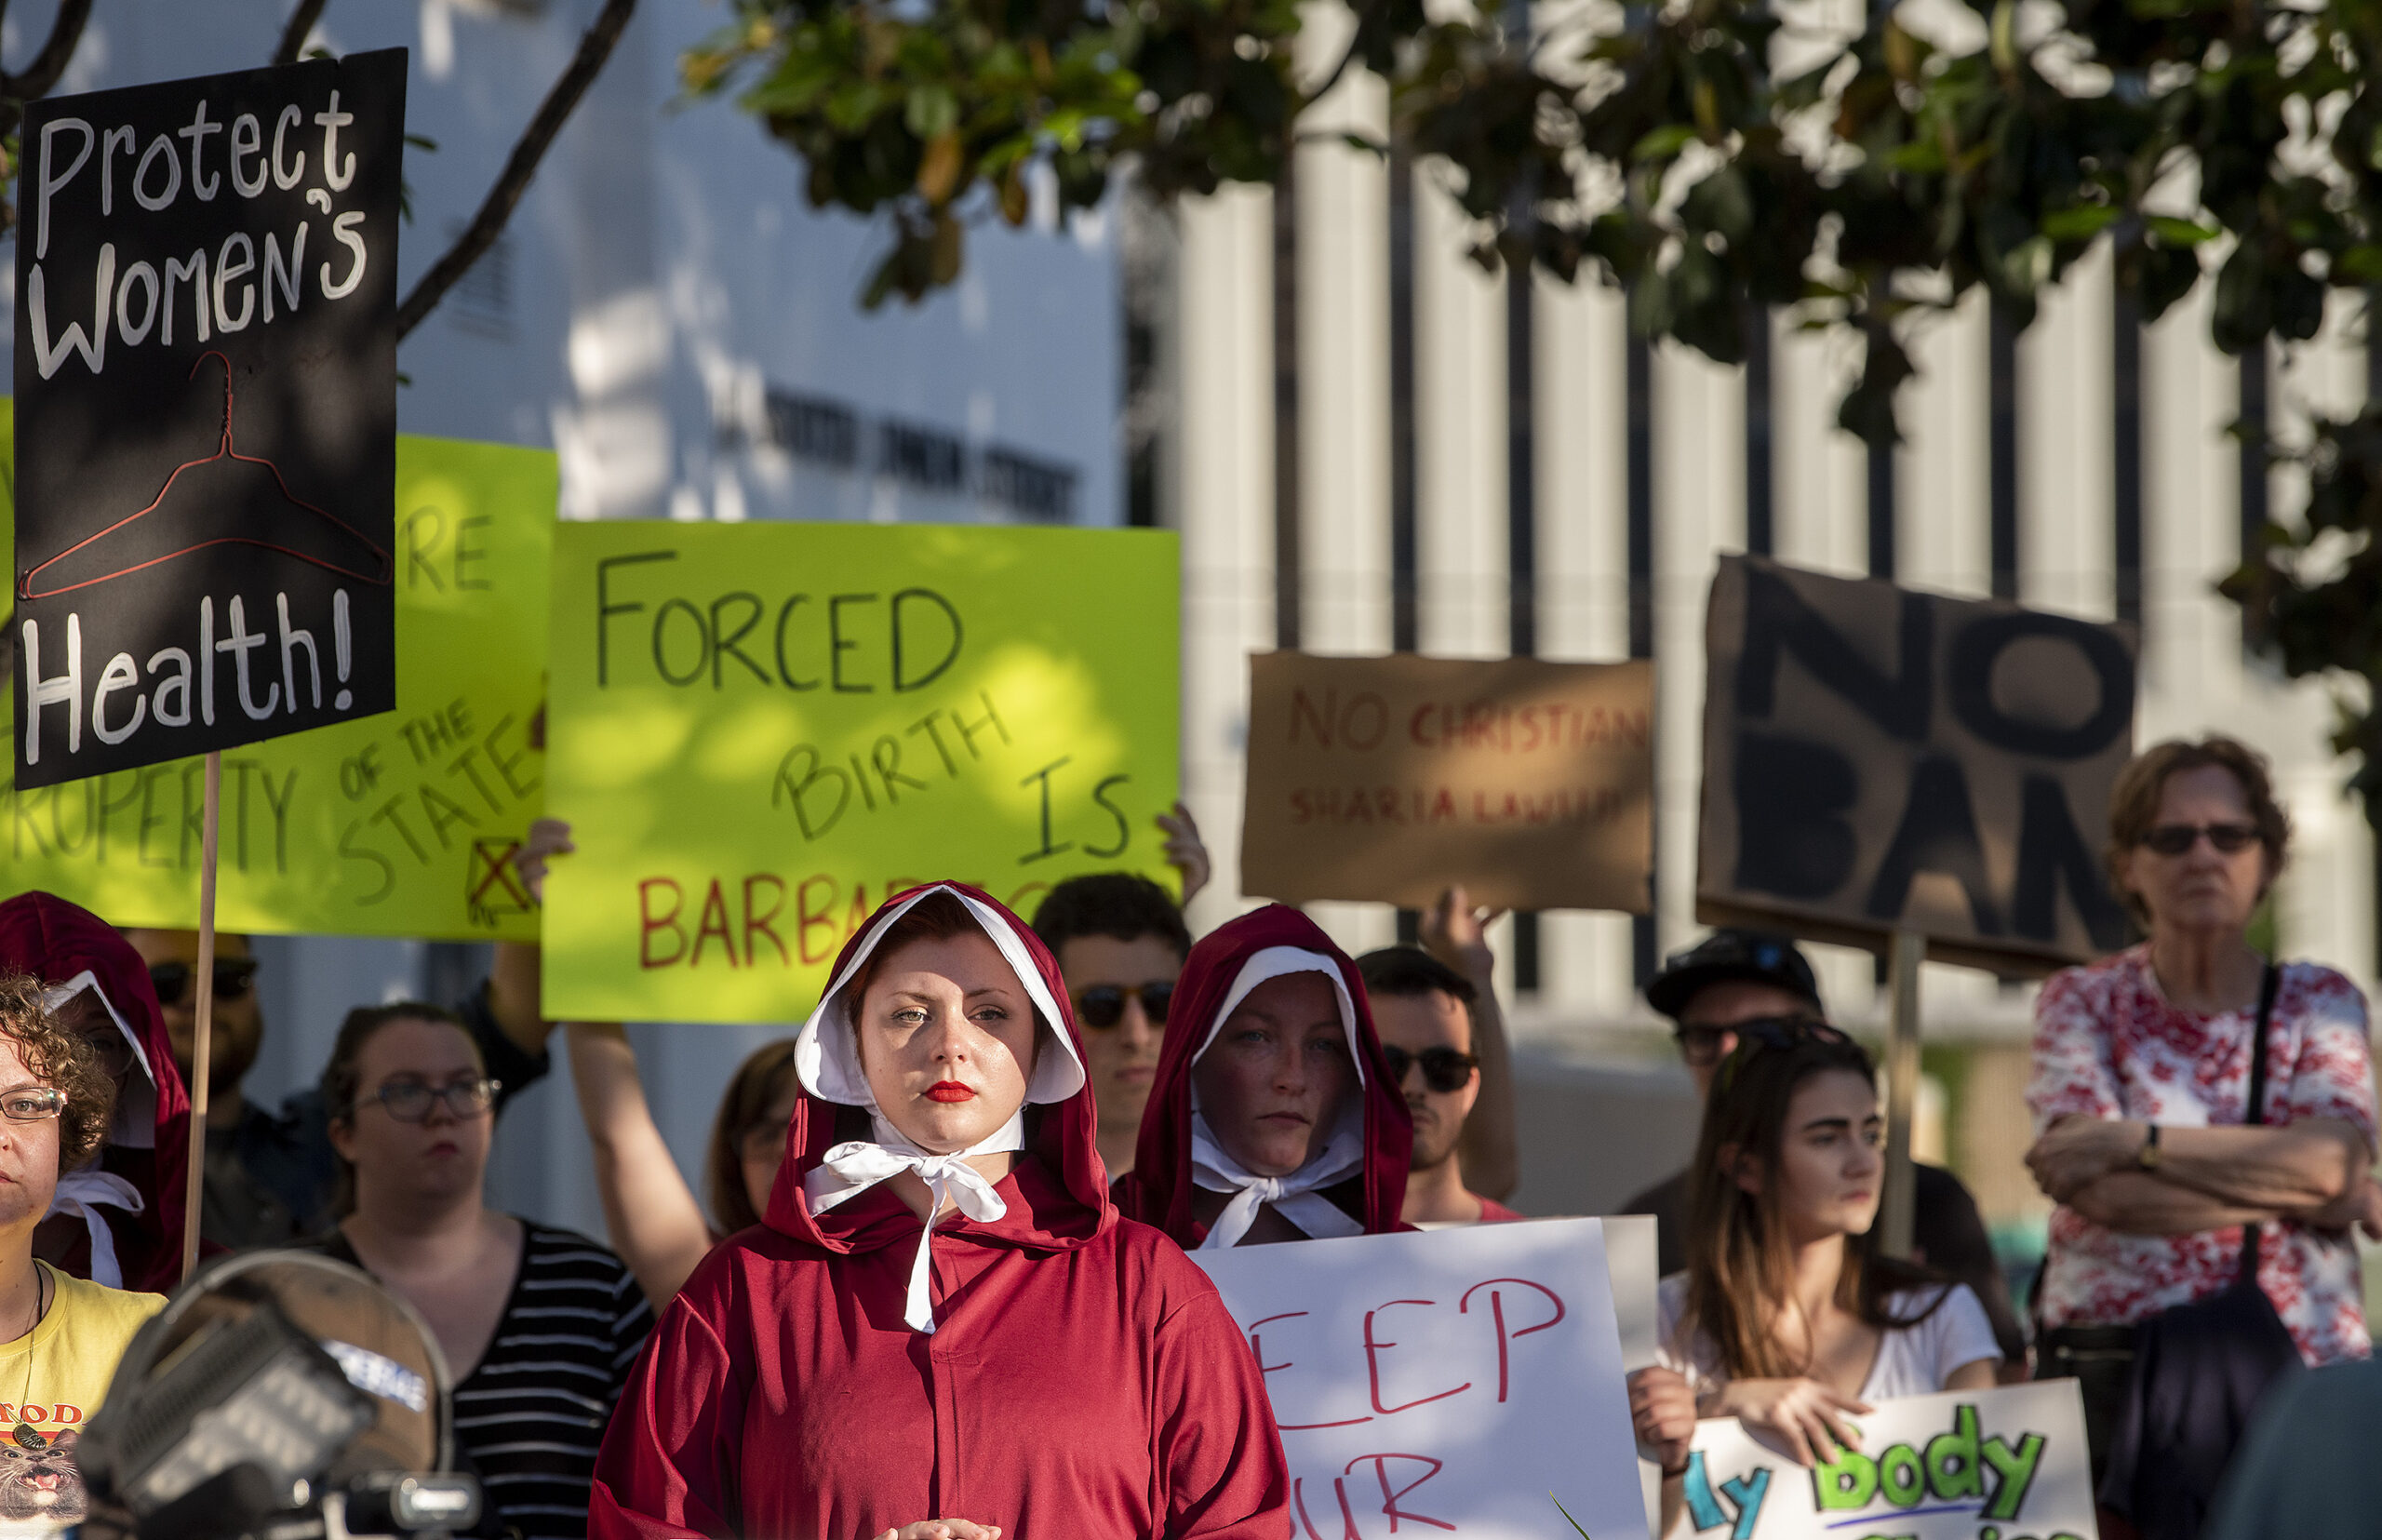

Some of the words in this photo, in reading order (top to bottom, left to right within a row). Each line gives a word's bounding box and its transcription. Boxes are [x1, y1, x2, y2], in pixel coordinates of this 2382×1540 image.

[36, 90, 356, 260] Protect
[398, 505, 494, 594] RE
[22, 588, 352, 766] Health!
[597, 550, 963, 693] FORCED
[1733, 560, 2136, 763] NO
[340, 742, 384, 802] OF
[397, 696, 474, 768] THE
[770, 690, 1011, 842] BIRTH
[1288, 686, 1390, 752] NO
[1410, 701, 1647, 752] CHRISTIAN
[0, 758, 299, 875] ROPERTY
[337, 711, 544, 908] STATE
[1017, 755, 1131, 865] IS
[1290, 785, 1458, 826] SHARIA
[1249, 1278, 1567, 1431] EEP
[1290, 1453, 1457, 1540] UR
